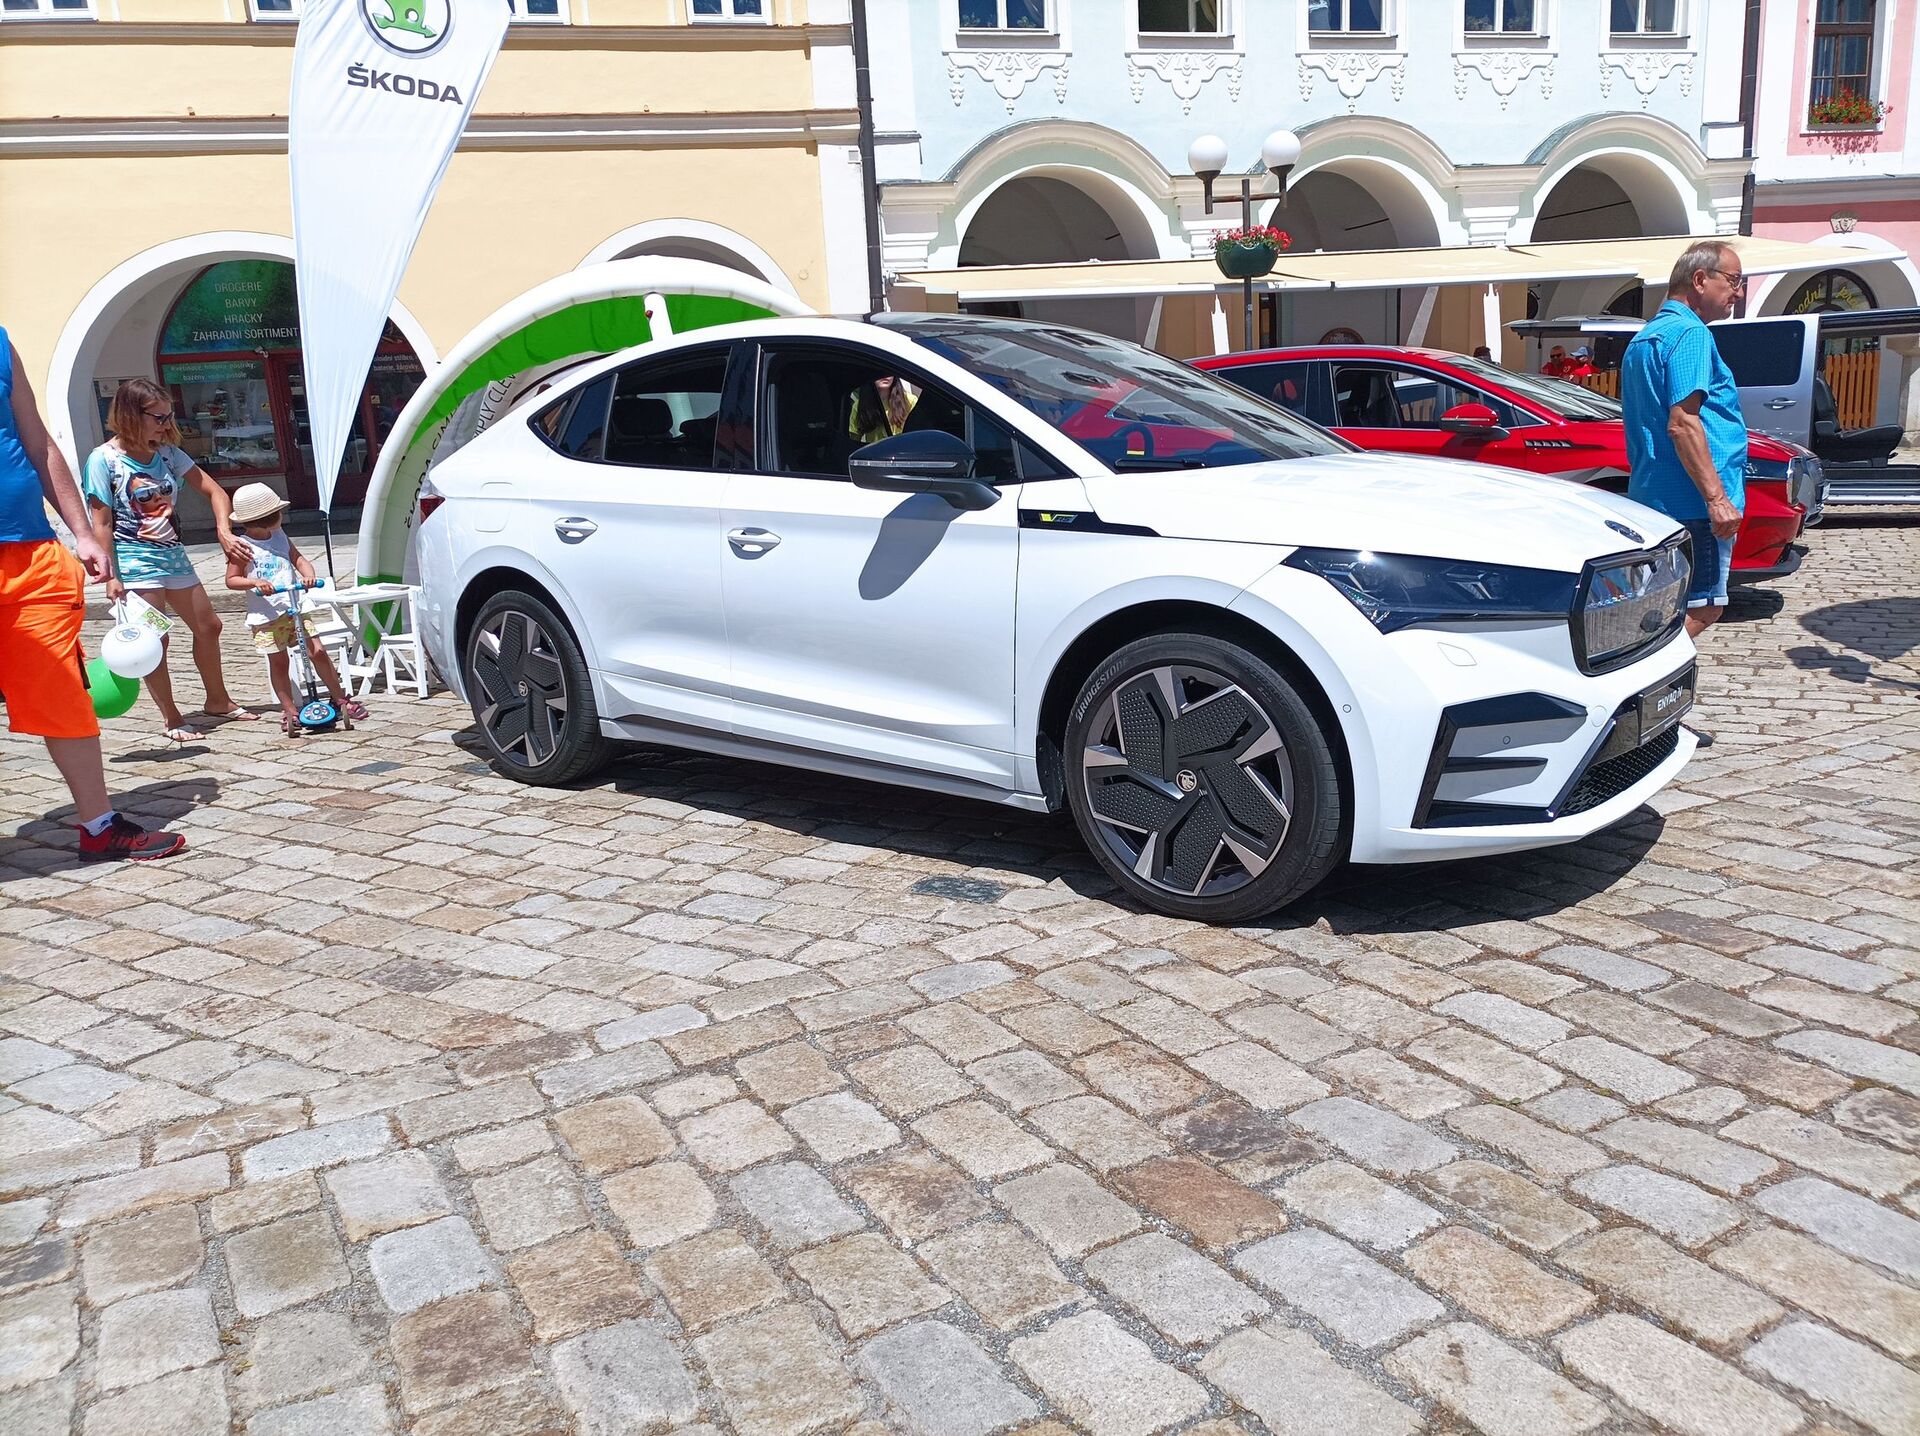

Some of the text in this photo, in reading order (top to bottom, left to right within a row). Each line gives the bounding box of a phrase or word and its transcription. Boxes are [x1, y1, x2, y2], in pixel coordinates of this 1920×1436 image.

[347, 62, 463, 105] ŠKODA
[215, 281, 262, 292] DROGERIE
[224, 298, 257, 308] BARVY
[244, 327, 299, 340] SORTIMENT
[1657, 690, 1677, 712] ENYAQ
